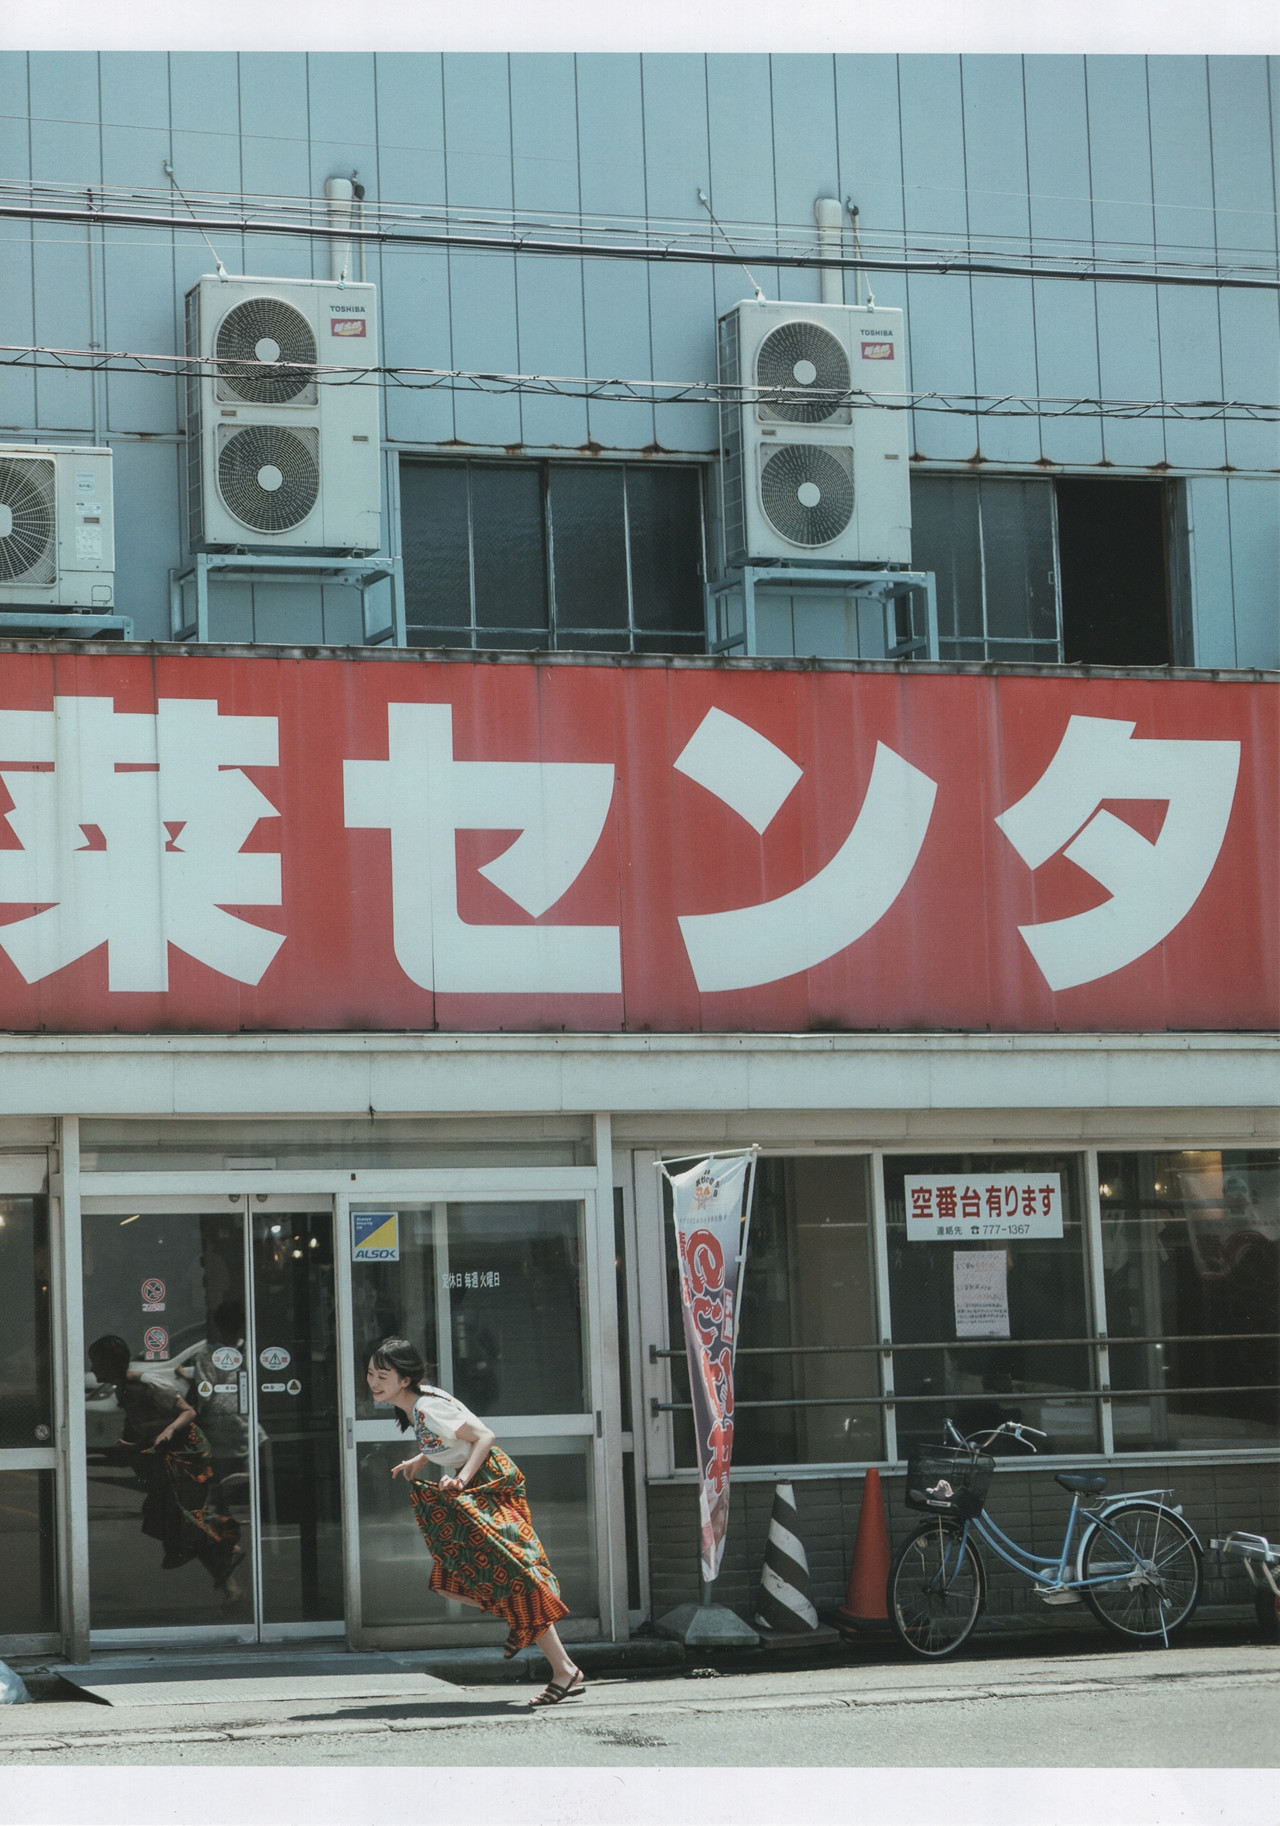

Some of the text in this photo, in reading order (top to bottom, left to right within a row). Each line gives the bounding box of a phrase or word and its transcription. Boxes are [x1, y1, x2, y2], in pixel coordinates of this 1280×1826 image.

[330, 305, 366, 313] TOSHIBA
[860, 329, 894, 337] TOSHIBA
[911, 1184, 1055, 1219] 空番台有ります
[937, 1224, 1030, 1236] 連絡先 777-1367
[355, 1249, 397, 1259] ALSOK
